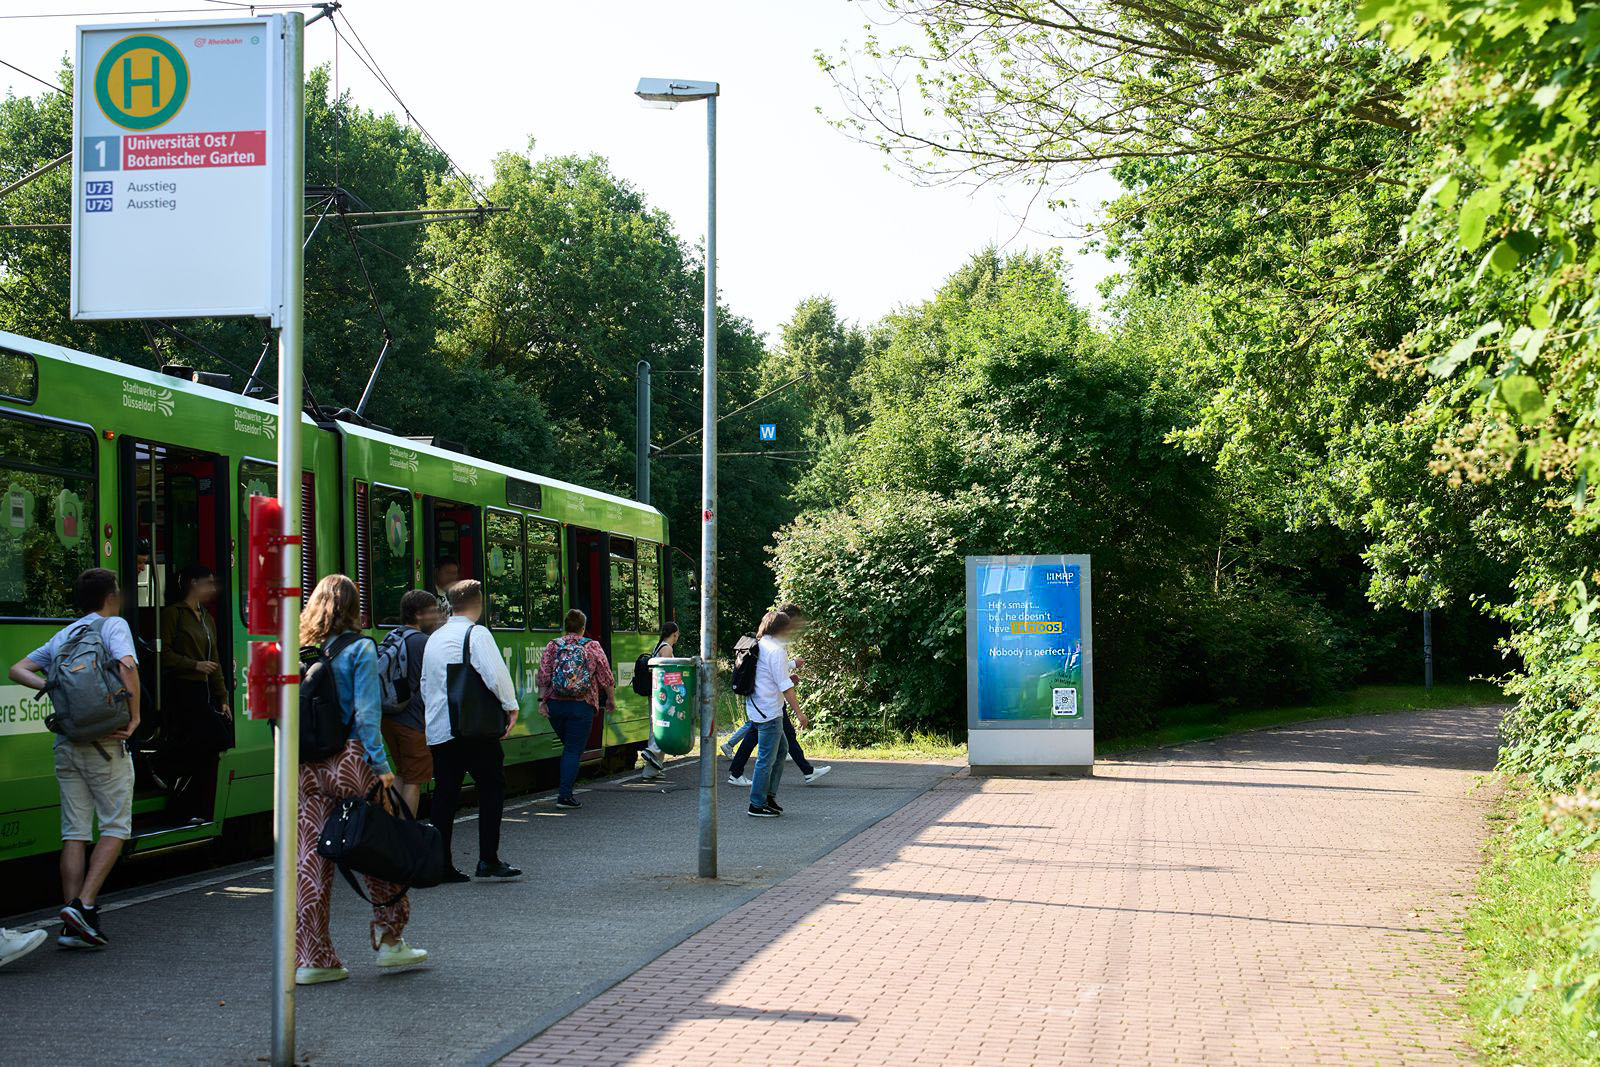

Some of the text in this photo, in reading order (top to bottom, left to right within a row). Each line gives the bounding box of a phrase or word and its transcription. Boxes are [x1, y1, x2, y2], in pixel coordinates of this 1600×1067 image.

[208, 38, 243, 46] Rheinbahn
[123, 56, 160, 109] H
[127, 134, 200, 150] Universität
[204, 134, 227, 148] Ost
[95, 141, 106, 167] 1
[127, 151, 255, 168] Botanischer Garten
[87, 181, 176, 194] U73 Ausstieg
[87, 198, 176, 211] U79 Ausstieg
[122, 380, 157, 398] Stadtwerke
[122, 394, 157, 413] Düsseldorf
[234, 407, 262, 422] Stadtwerke
[234, 420, 262, 436] Düsseldorf
[761, 426, 775, 439] W
[1006, 612, 1017, 621] he
[1019, 611, 1051, 621] doesn't
[988, 624, 1010, 633] have
[989, 648, 1024, 658] Nobody
[1025, 648, 1033, 656] is
